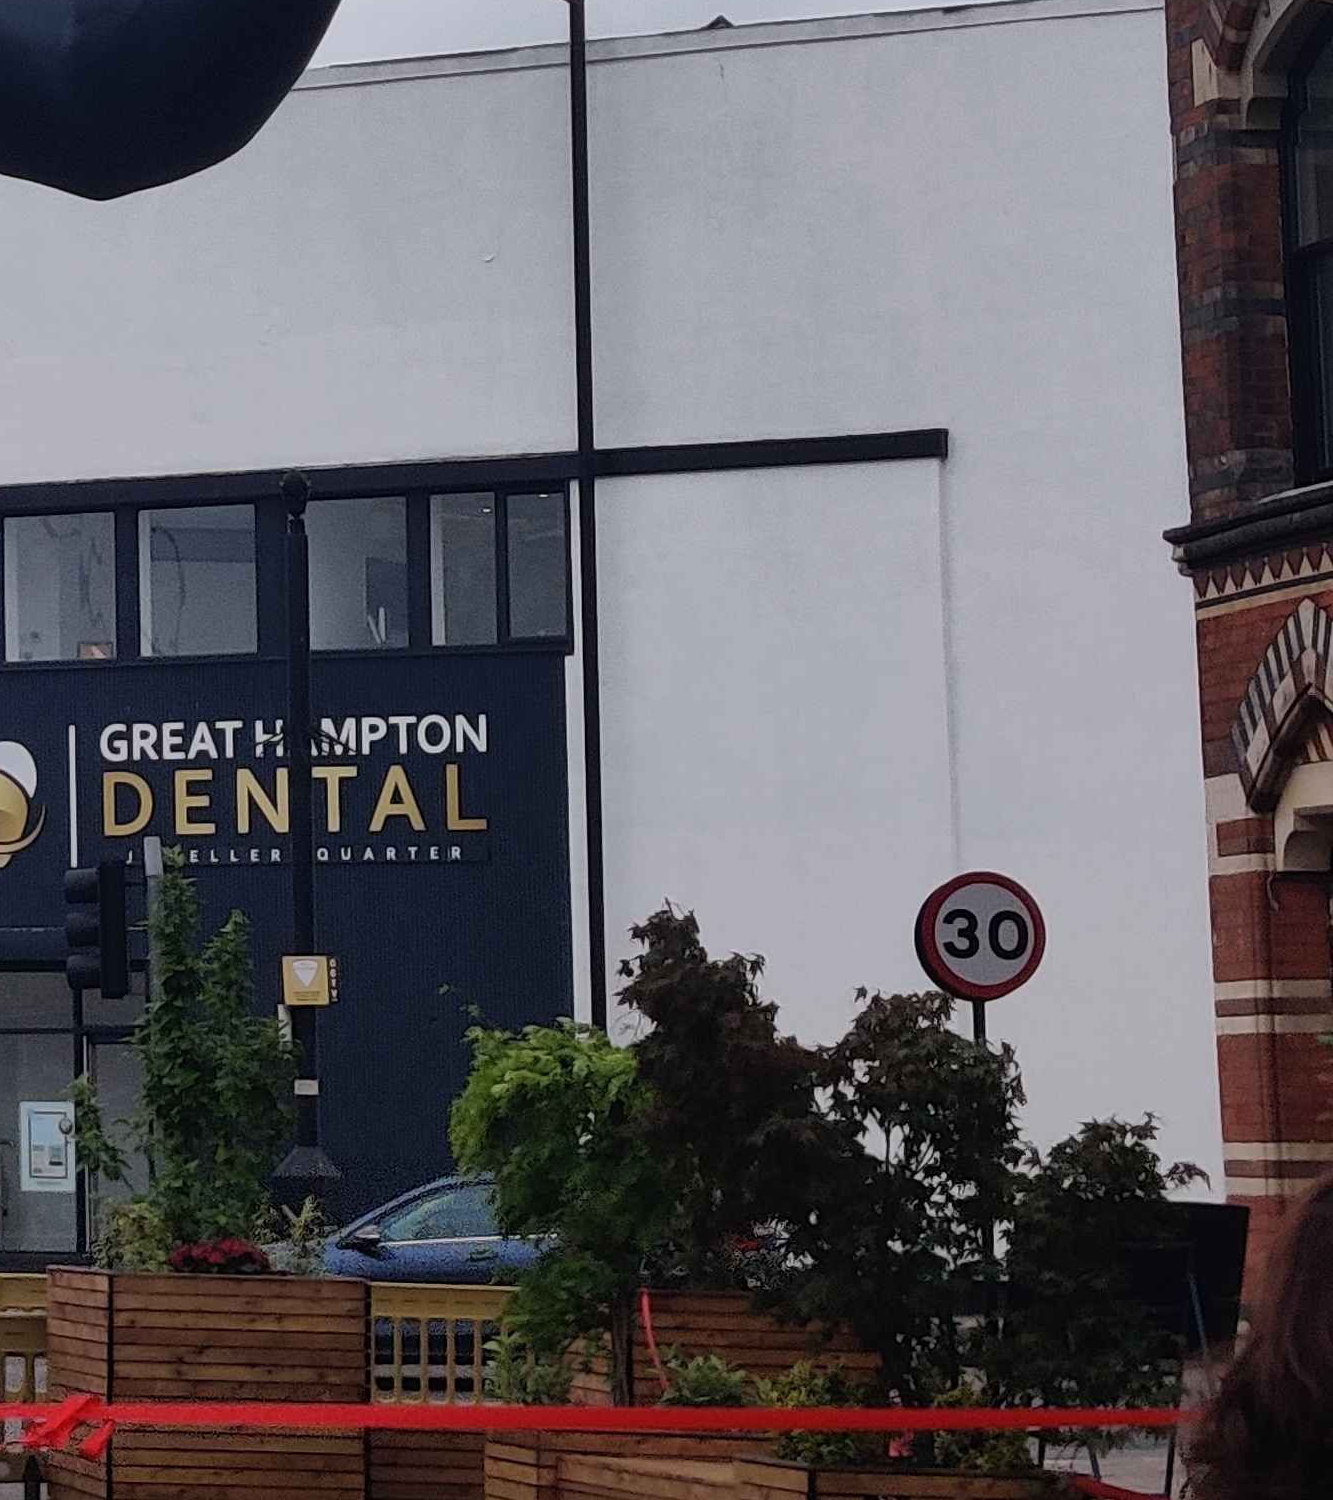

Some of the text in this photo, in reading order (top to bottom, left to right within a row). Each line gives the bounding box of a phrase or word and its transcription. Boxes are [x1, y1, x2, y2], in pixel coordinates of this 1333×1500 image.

[99, 713, 488, 762] GREAT HMPTON
[102, 763, 488, 837] DENTAL
[316, 845, 463, 862] QUARTER
[942, 908, 1029, 961] 30
